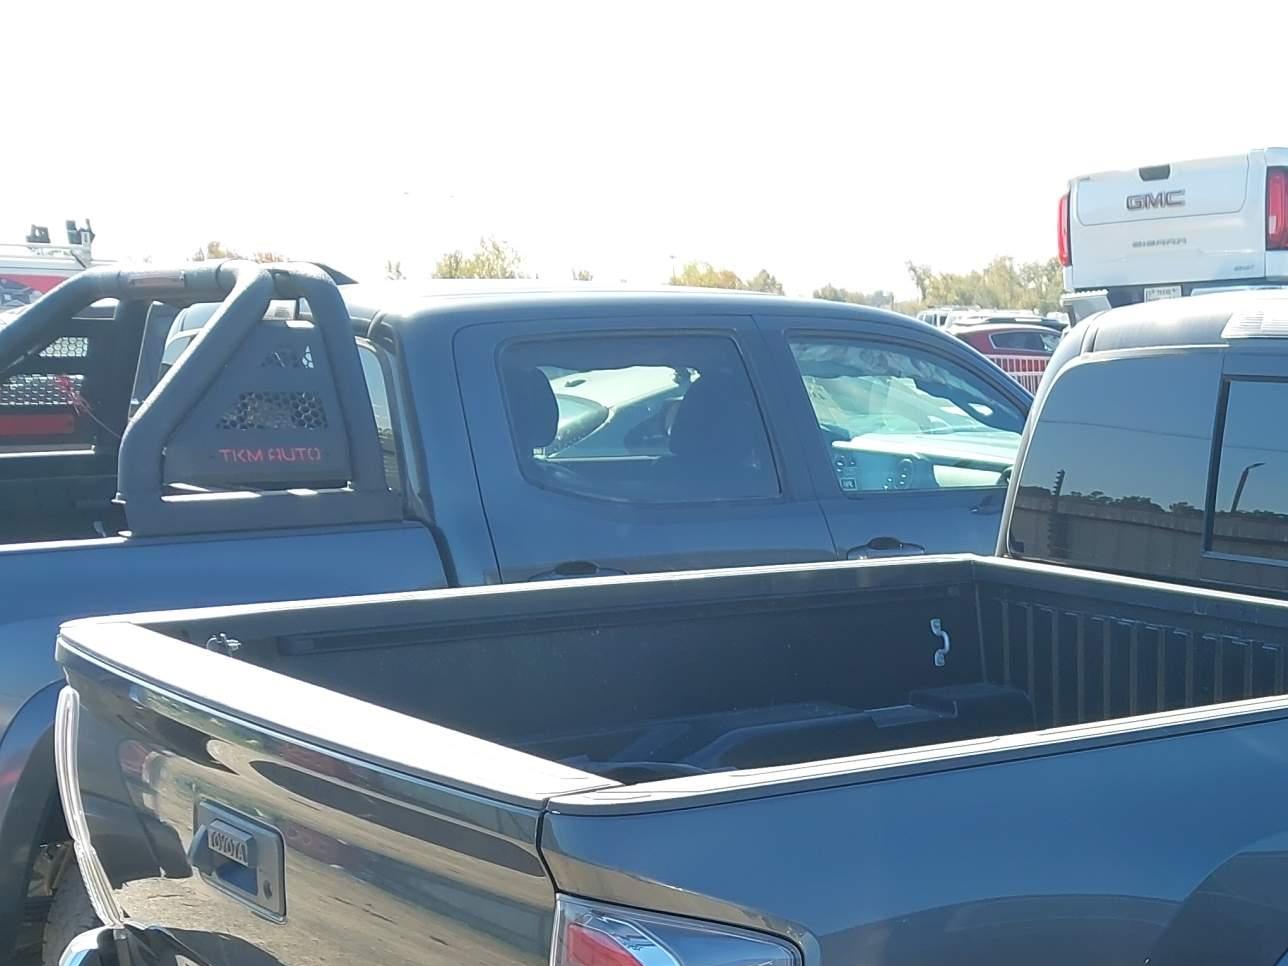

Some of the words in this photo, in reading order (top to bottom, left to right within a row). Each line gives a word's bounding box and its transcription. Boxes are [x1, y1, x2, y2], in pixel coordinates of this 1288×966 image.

[1126, 189, 1186, 211] GMC
[218, 447, 264, 464] TKM
[267, 446, 321, 462] AUTO
[207, 829, 249, 867] TOYOTA
